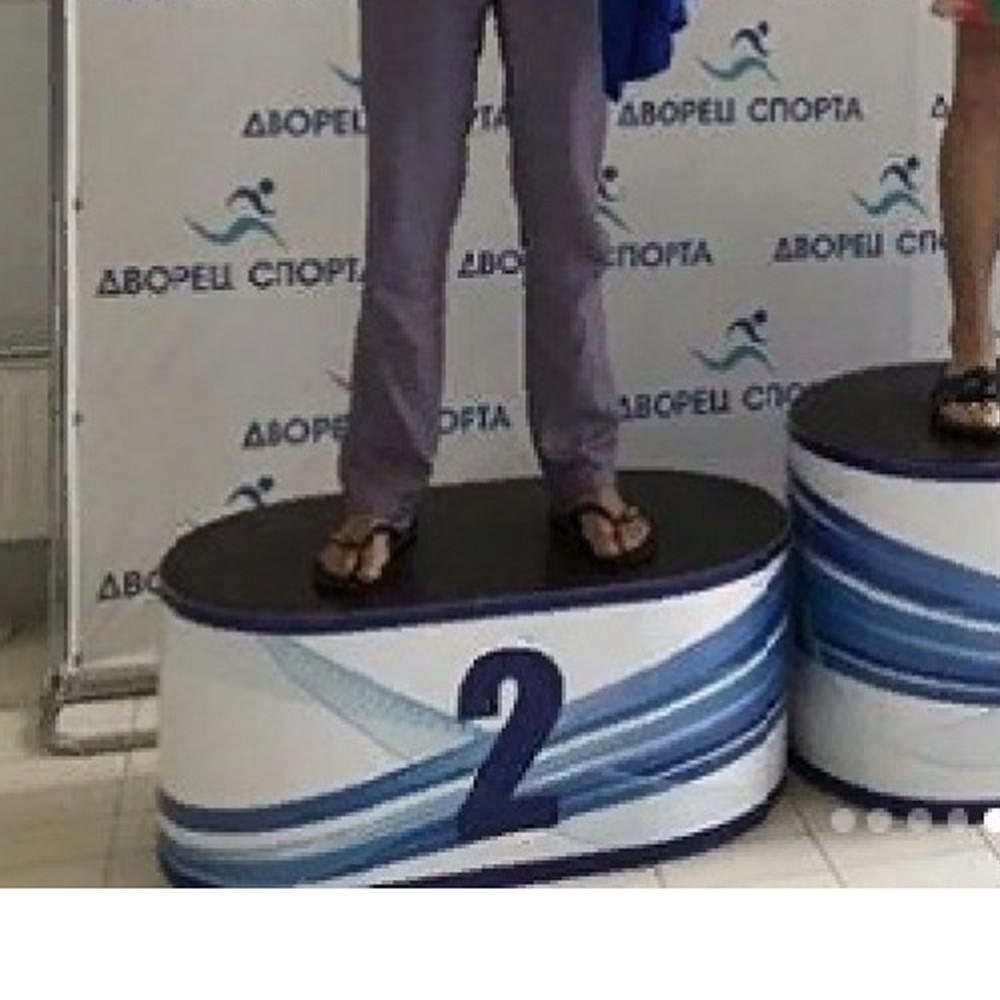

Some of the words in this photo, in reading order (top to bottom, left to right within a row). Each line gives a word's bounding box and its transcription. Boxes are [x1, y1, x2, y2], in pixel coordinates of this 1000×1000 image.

[617, 98, 735, 127] ДВОРЕЦ
[747, 96, 864, 123] СПОРТА
[773, 233, 884, 262] ДВОРЕЦ
[97, 263, 235, 296] ДВОРЕЦ
[248, 256, 366, 289] СПОРТ
[457, 250, 526, 279] ДВО
[742, 382, 800, 412] СПО
[242, 413, 350, 450] ДВОРЕ
[437, 405, 511, 436] ОРТА
[97, 570, 160, 600] ДВО
[457, 647, 562, 838] 2
